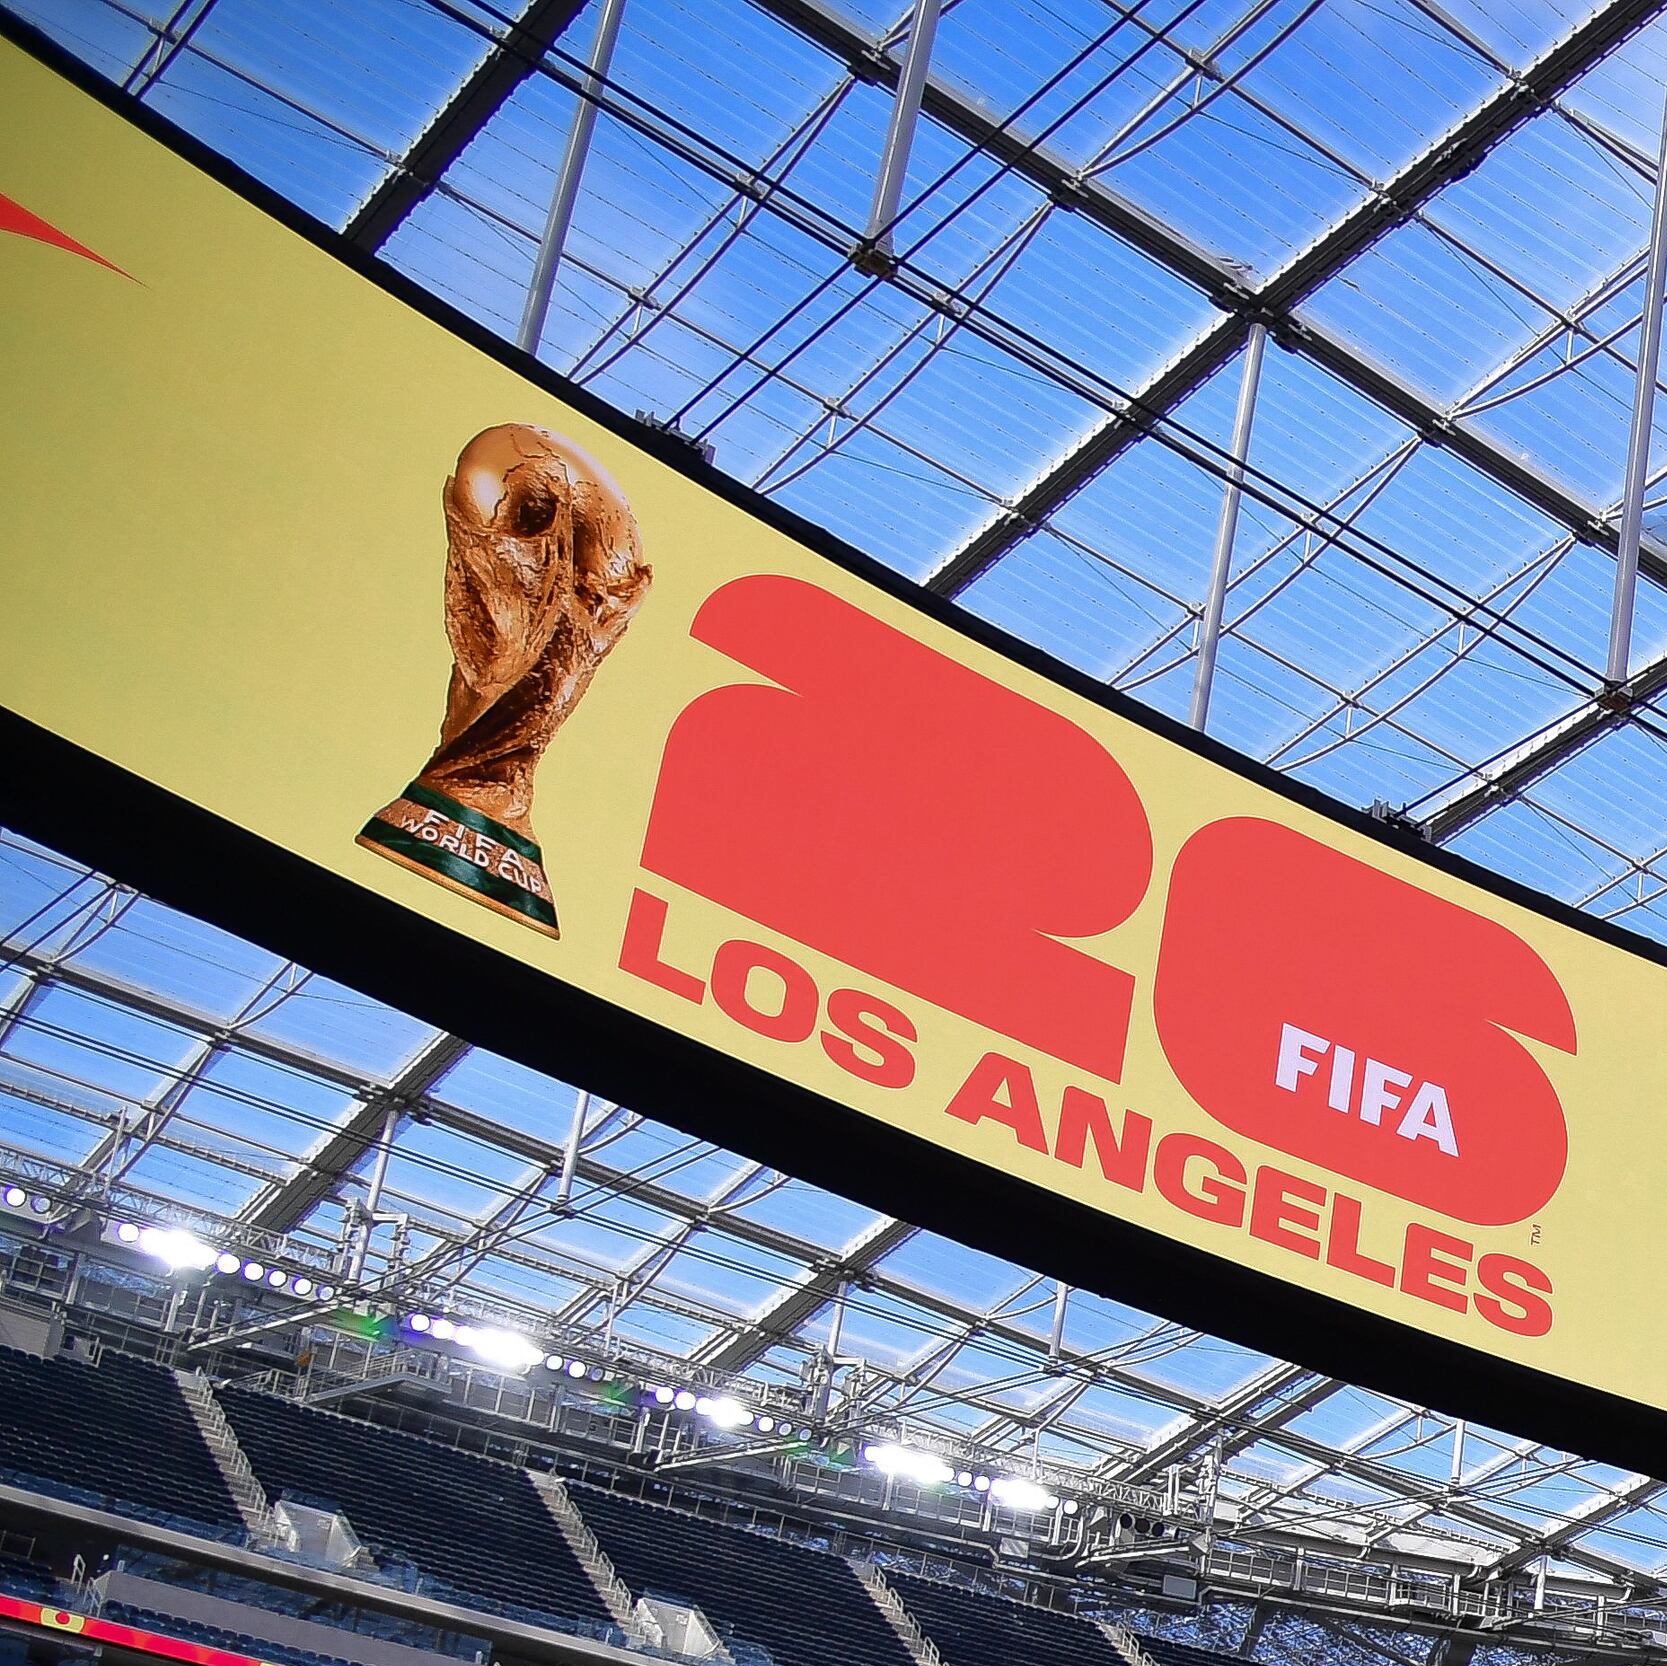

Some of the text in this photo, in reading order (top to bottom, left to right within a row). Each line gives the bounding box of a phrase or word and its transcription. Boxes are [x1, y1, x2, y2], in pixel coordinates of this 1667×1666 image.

[400, 815, 542, 893] WORLD CUP
[423, 808, 524, 871] FIFA
[640, 574, 1578, 1227] 26
[617, 887, 1553, 1337] LOS ANGELES
[1275, 1022, 1459, 1157] FIFA
